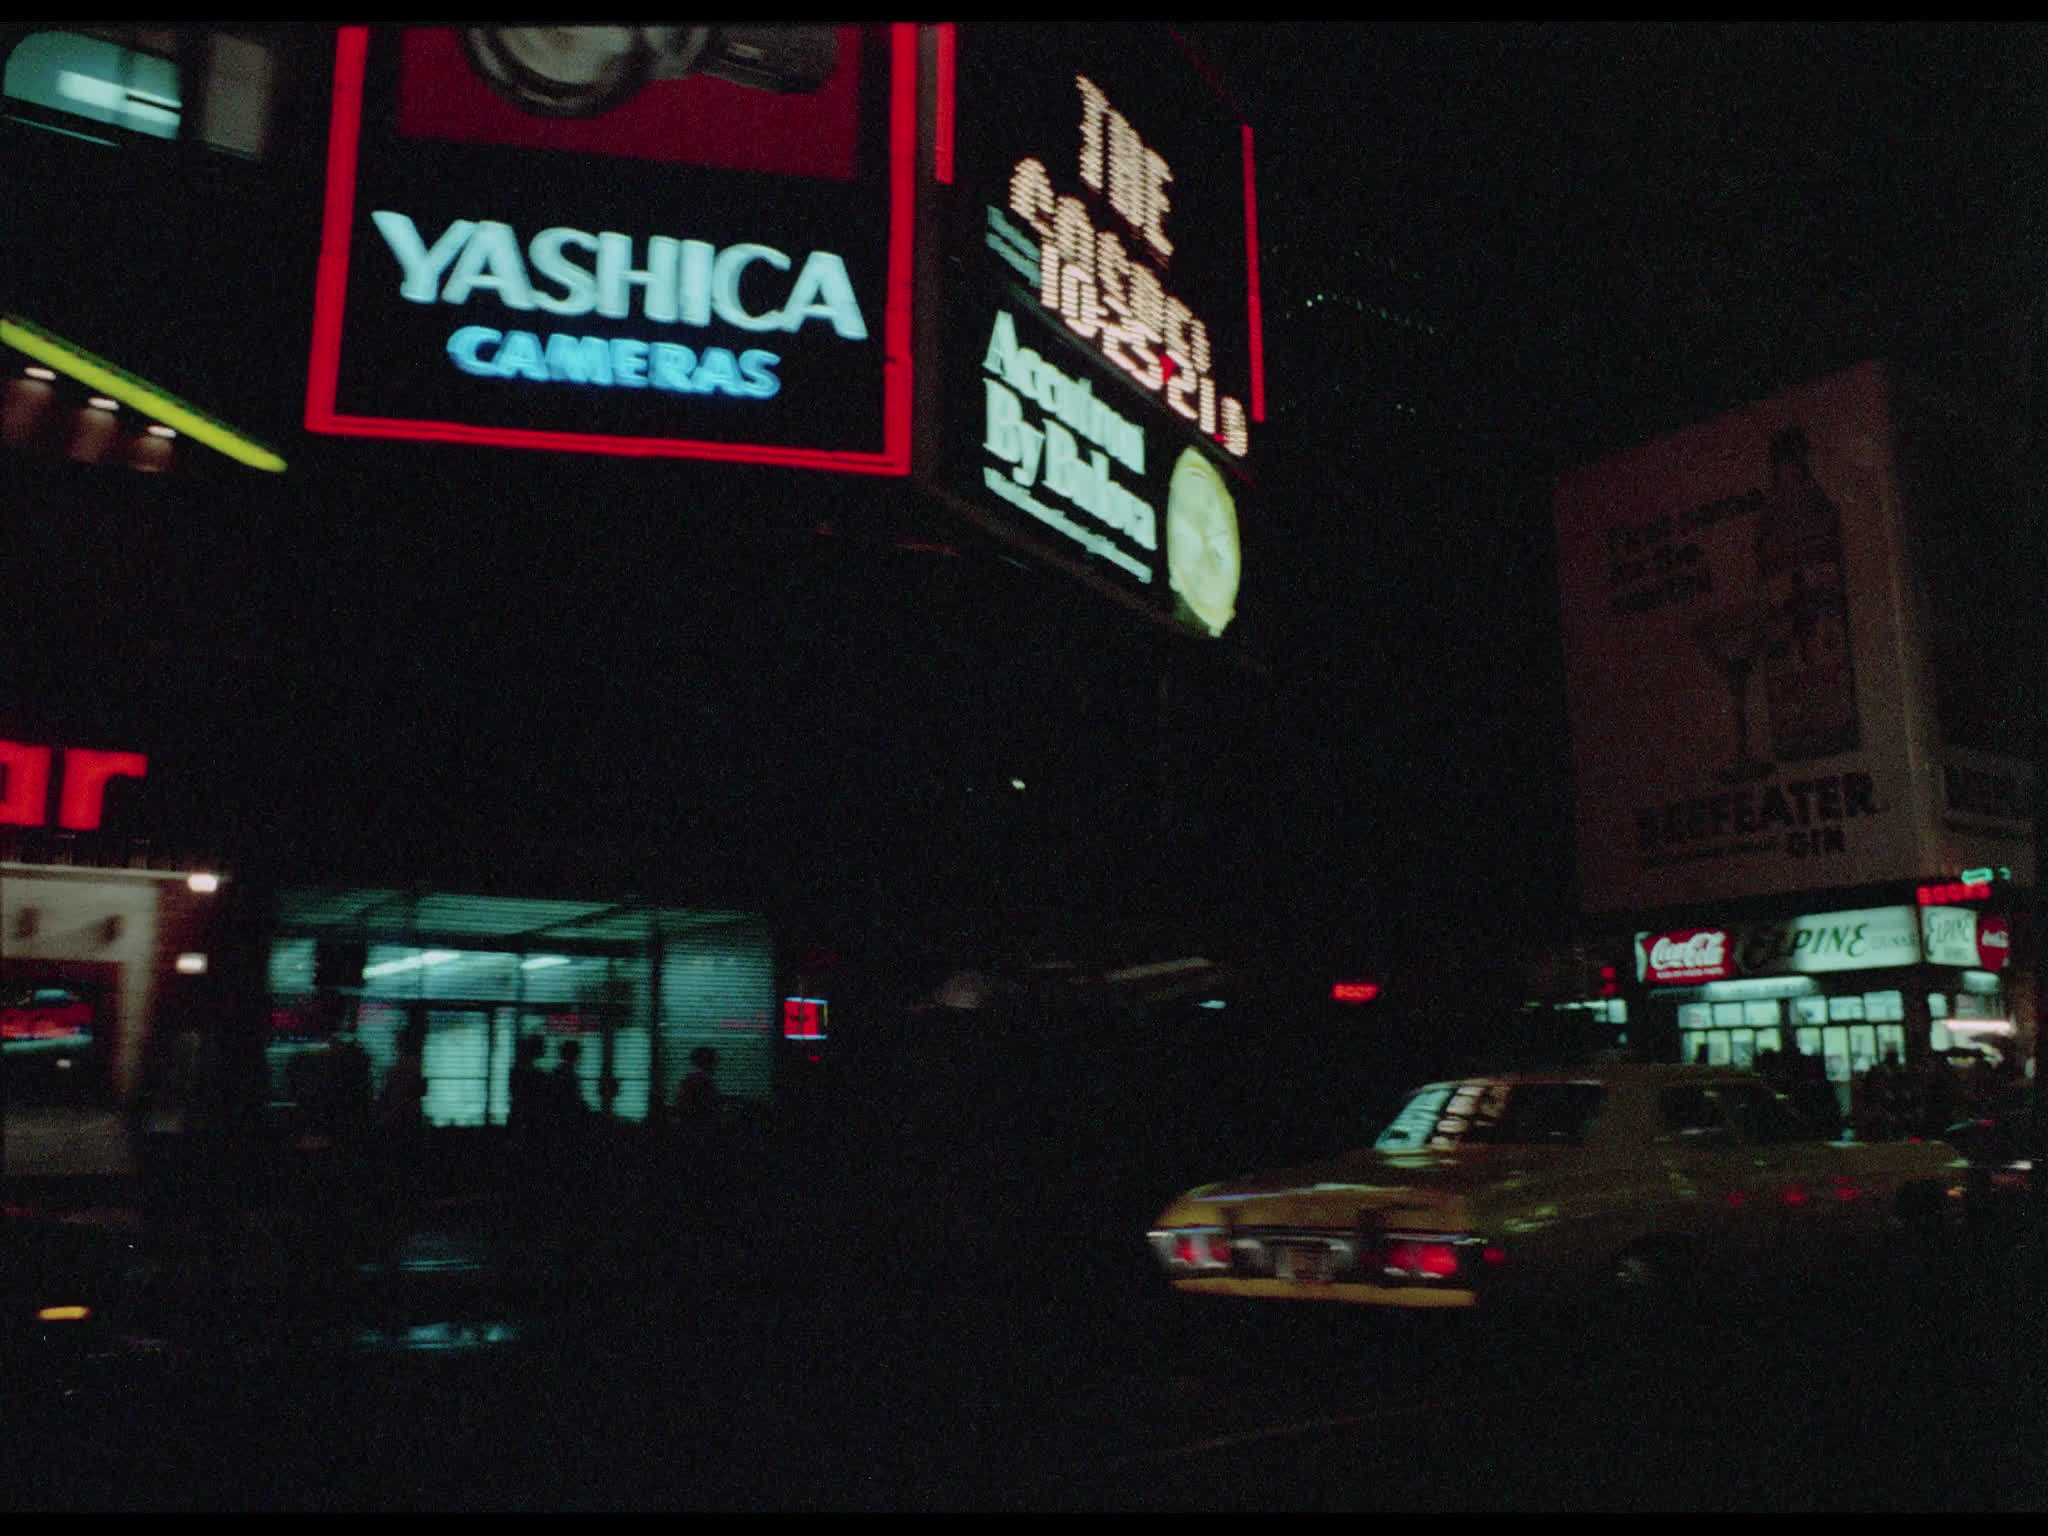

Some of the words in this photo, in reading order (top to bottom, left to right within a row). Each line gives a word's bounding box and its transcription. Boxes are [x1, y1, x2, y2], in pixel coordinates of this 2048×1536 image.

[371, 209, 869, 341] YASHICA
[446, 325, 782, 400] CAMERAS
[982, 377, 1047, 488] By
[1786, 825, 1846, 860] GIN
